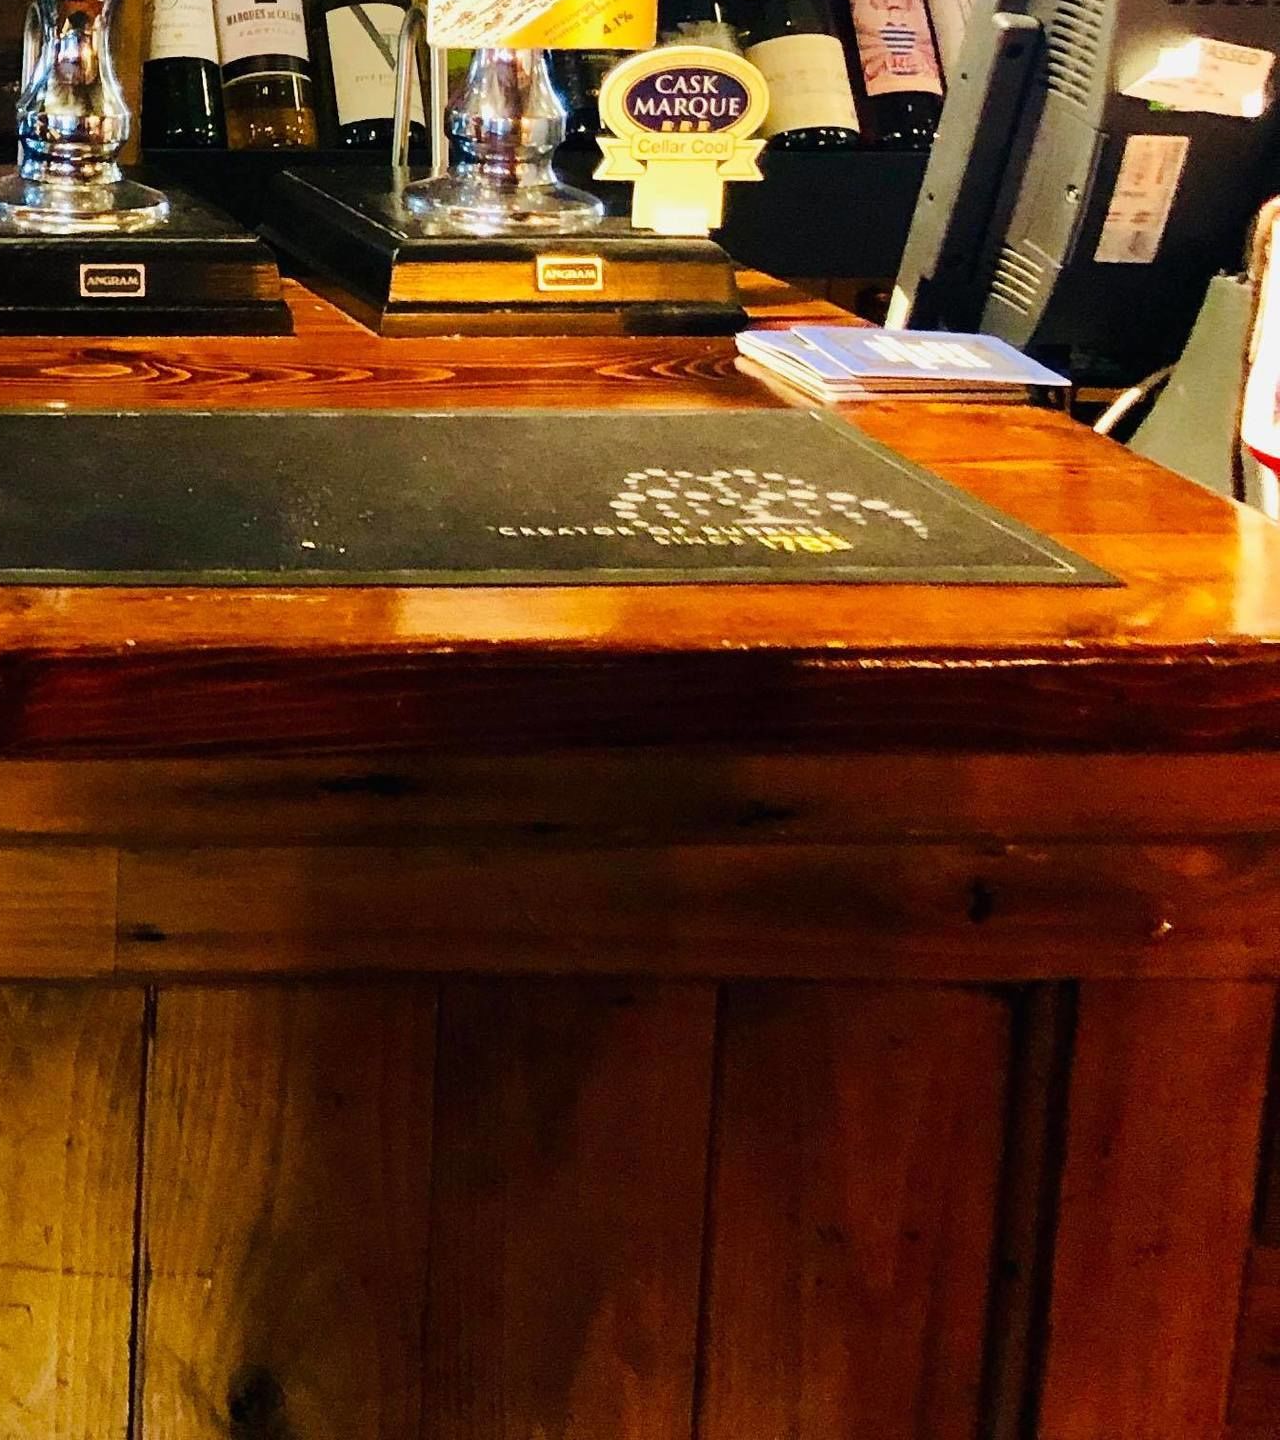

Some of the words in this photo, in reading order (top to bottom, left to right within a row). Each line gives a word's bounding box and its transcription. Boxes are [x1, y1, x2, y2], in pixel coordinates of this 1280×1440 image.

[655, 75, 719, 94] CASK
[633, 97, 741, 118] MARQUE
[638, 139, 685, 154] Cellar
[691, 139, 728, 154] Cool
[86, 273, 139, 286] ANGRAM
[542, 268, 596, 282] ANGRAM
